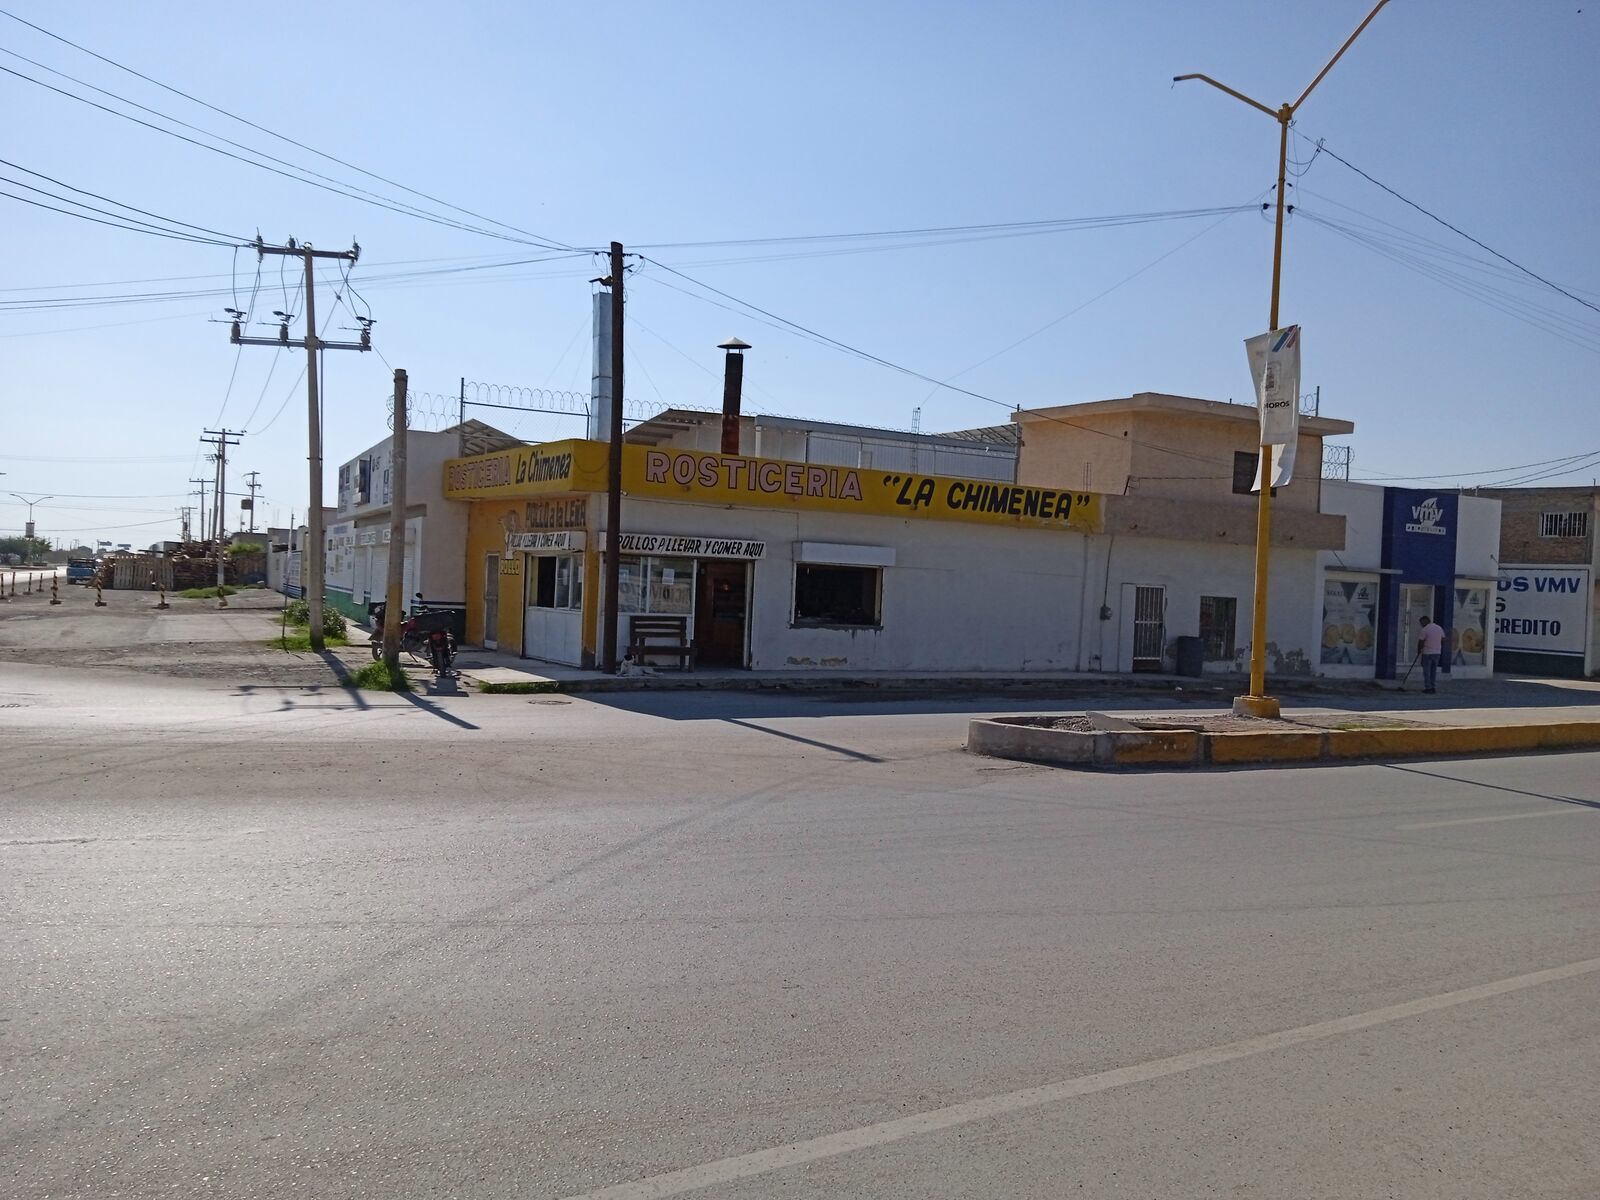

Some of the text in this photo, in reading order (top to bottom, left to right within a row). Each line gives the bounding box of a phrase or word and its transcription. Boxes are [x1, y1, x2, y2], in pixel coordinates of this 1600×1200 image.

[515, 454, 527, 484] La
[527, 450, 572, 483] Chimenea
[645, 451, 863, 501] ROSTICERIA
[704, 540, 712, 555] Y
[712, 541, 745, 556] COMER
[743, 542, 765, 557] AQUI
[1534, 576, 1581, 593] VMV
